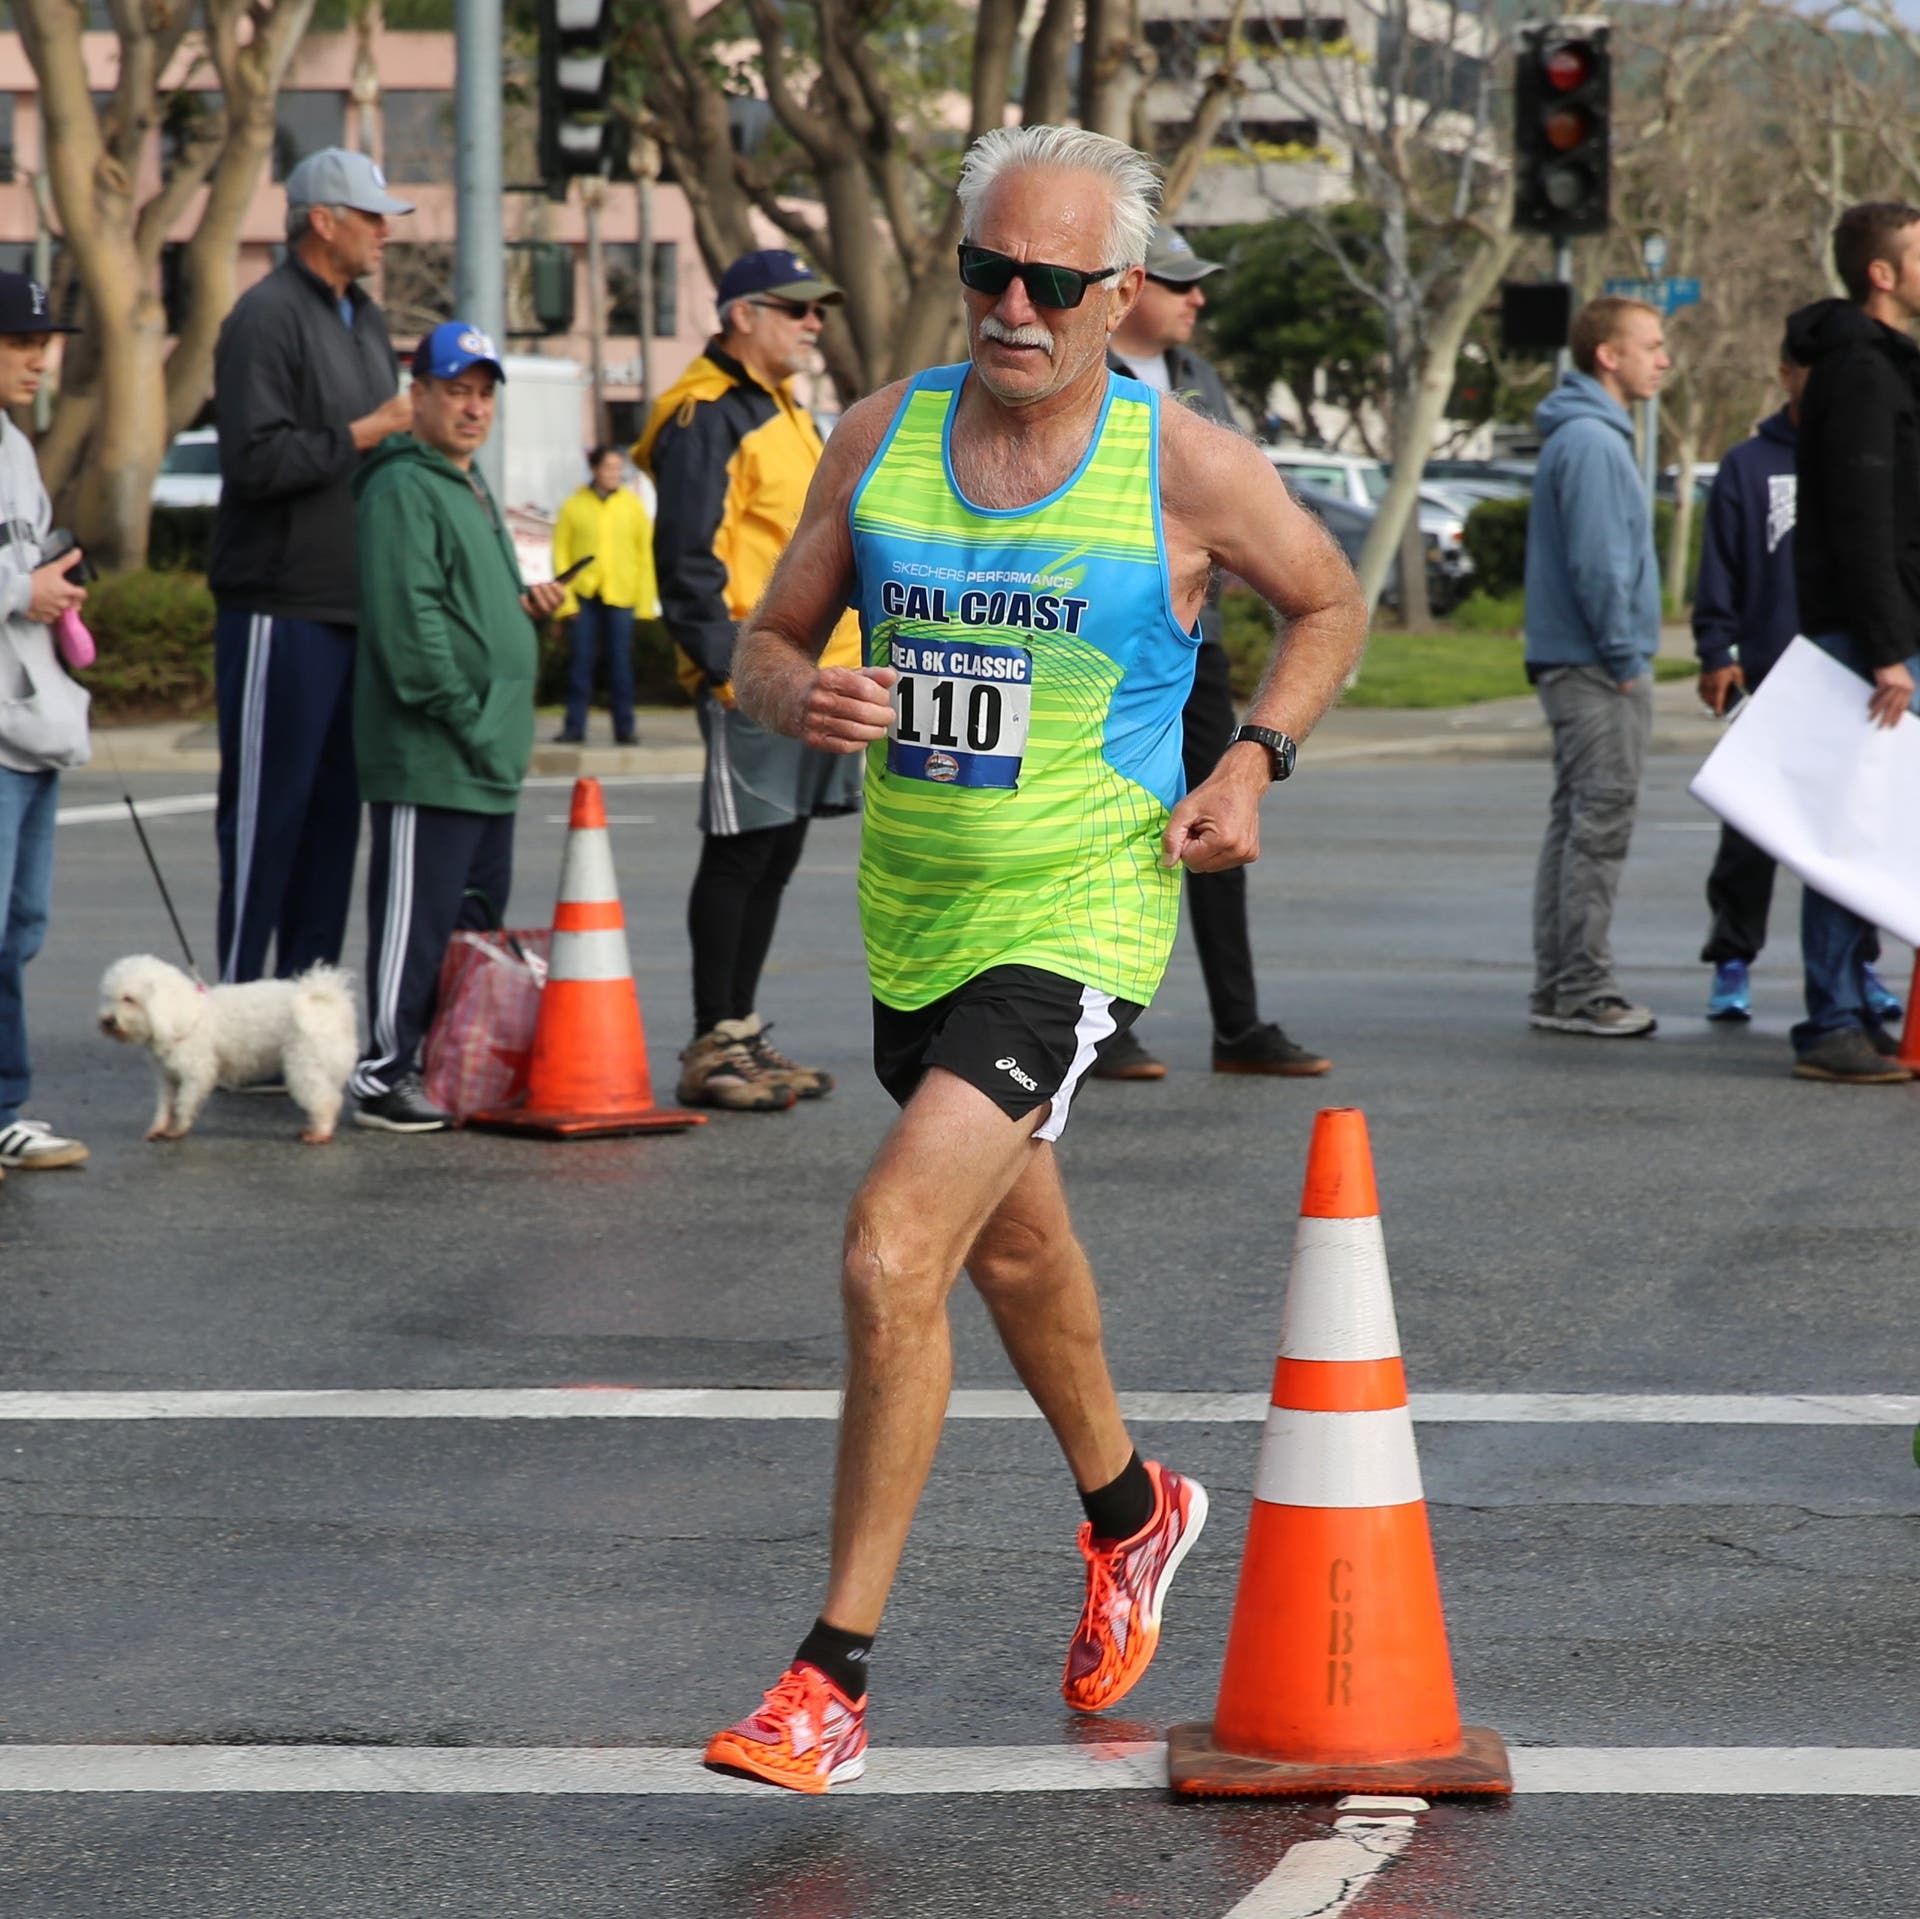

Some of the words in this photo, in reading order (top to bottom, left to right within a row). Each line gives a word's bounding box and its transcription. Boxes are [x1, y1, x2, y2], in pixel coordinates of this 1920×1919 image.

[882, 580, 951, 624] CAL
[960, 590, 1089, 635] COAST
[921, 650, 946, 673] 8K
[950, 652, 1027, 681] CLASSIC
[896, 676, 1002, 752] 110
[1328, 1558, 1354, 1706] CBR
